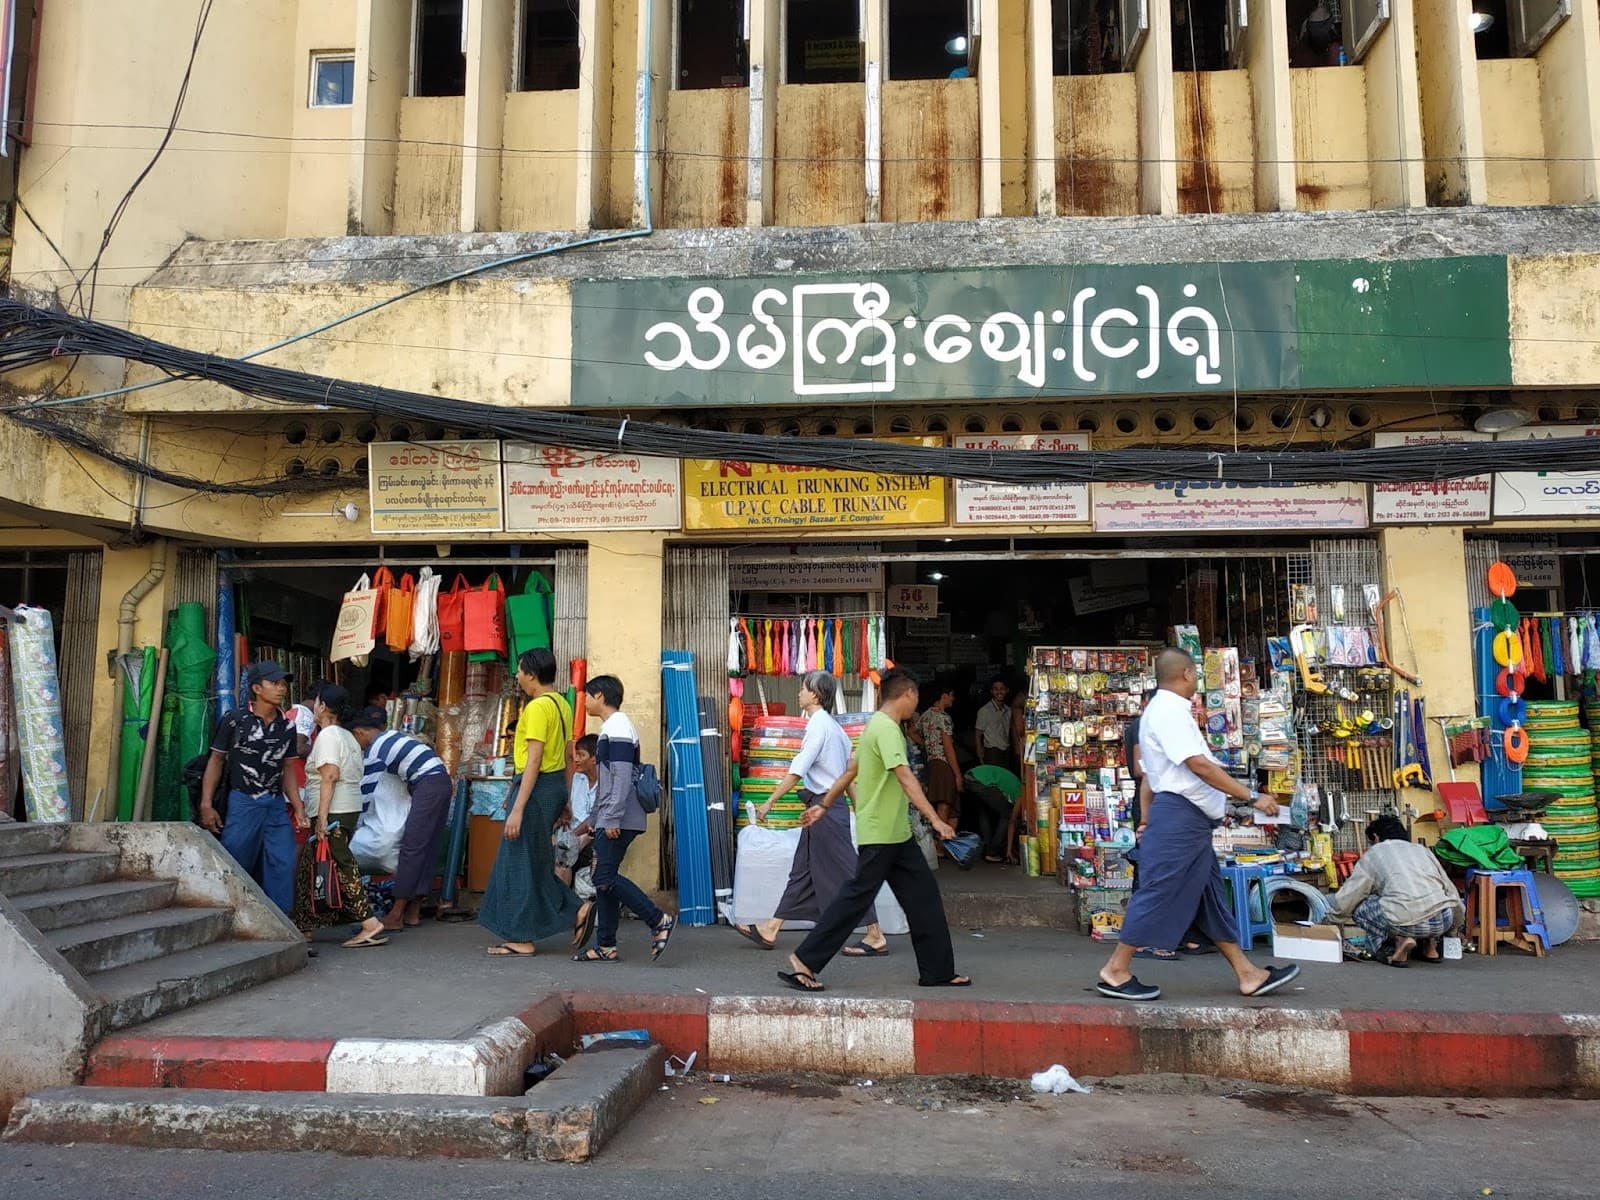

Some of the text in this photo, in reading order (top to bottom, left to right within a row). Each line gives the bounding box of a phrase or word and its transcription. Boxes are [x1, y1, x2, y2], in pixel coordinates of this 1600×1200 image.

[700, 475, 930, 497] ELECTRICAL TRUNKING SYSTEM
[725, 495, 908, 515] U.P.V.C CABLE TRUNKING
[901, 588, 922, 602] 56
[1066, 792, 1081, 802] TV
